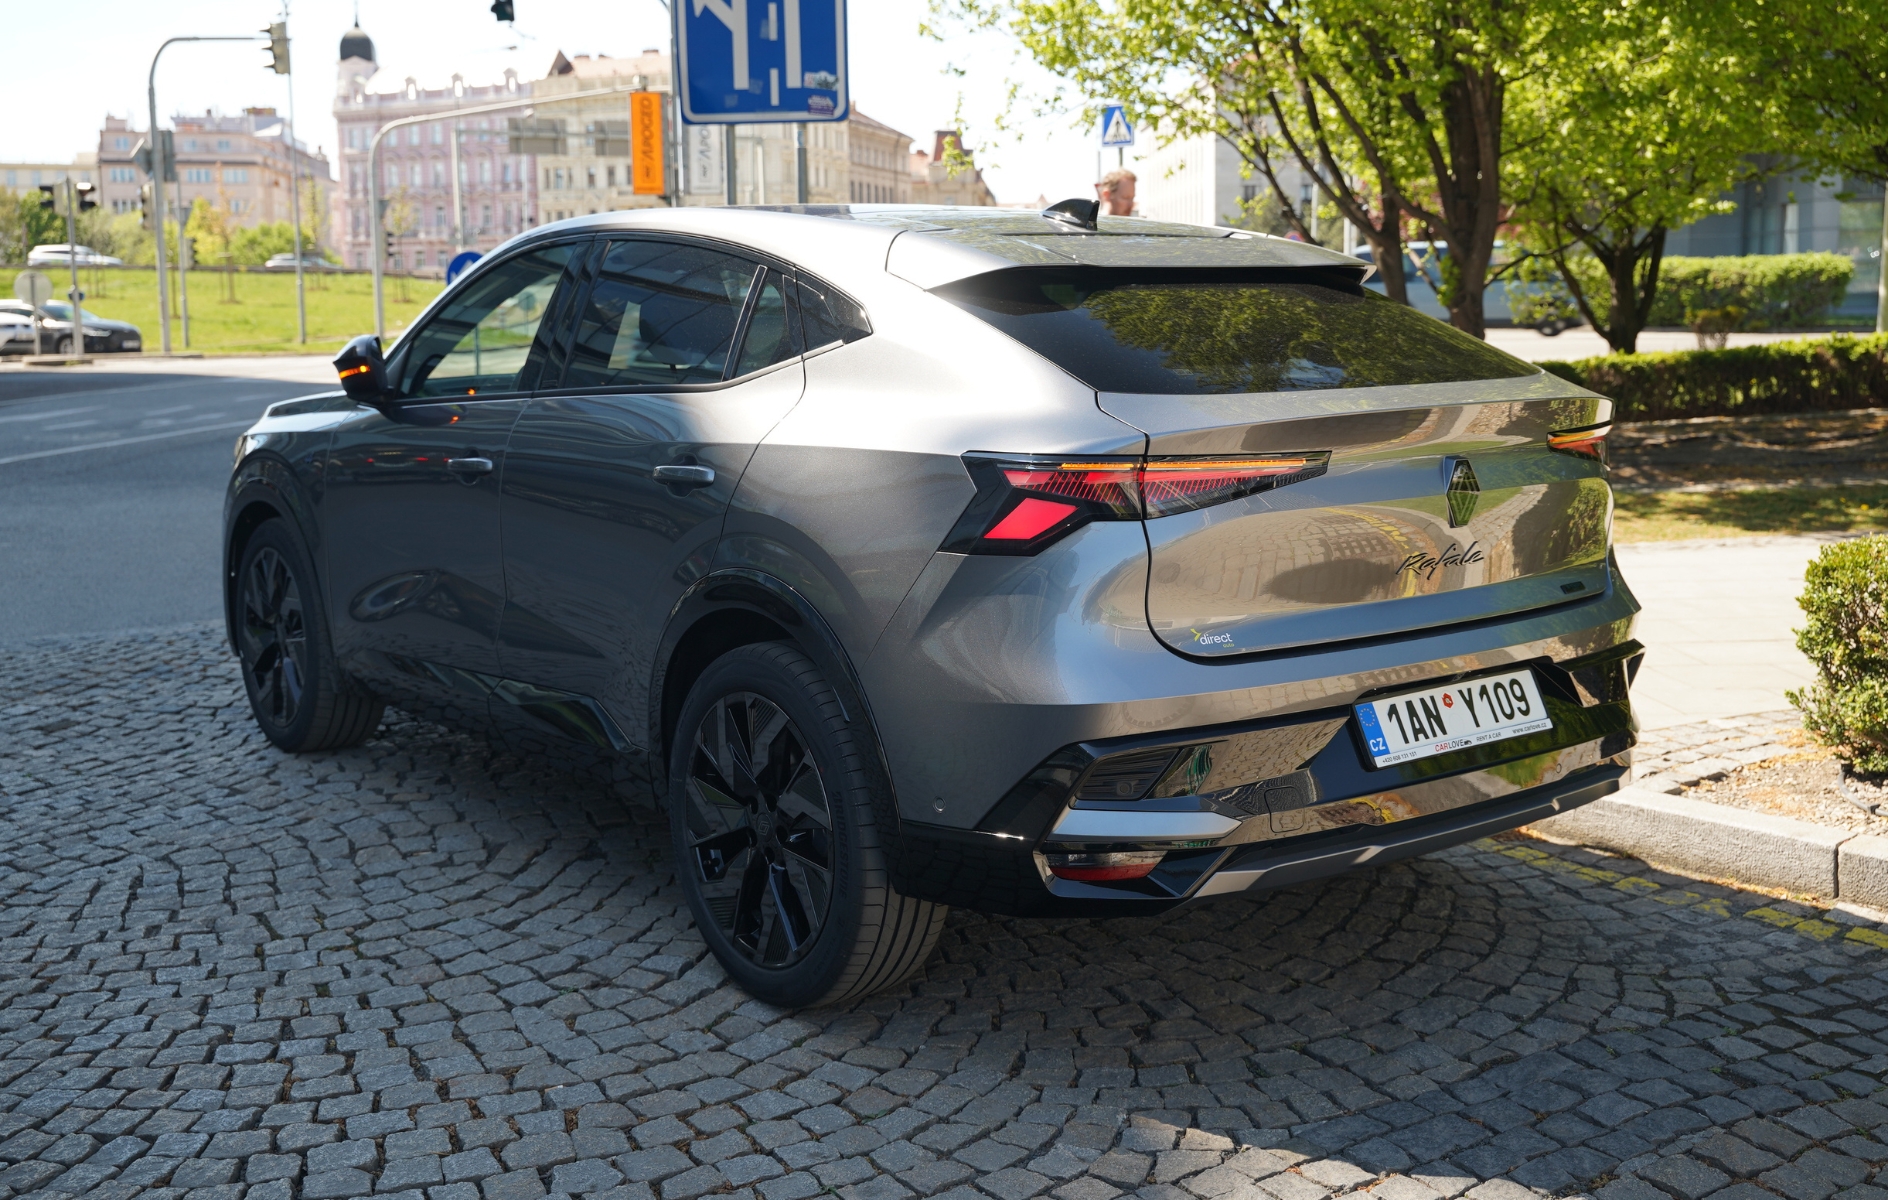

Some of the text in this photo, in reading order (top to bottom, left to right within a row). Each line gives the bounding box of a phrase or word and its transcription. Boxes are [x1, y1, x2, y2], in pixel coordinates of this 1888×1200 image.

[639, 98, 654, 161] APOGEO
[698, 124, 712, 160] APO
[1395, 541, 1484, 580] Rafale
[1200, 633, 1233, 645] direct
[1387, 678, 1531, 744] 1AN Y109
[1476, 734, 1489, 742] RENT
[1492, 731, 1502, 739] CAR
[1512, 722, 1547, 734] www.carlove.cz
[1369, 737, 1386, 753] CZ
[1434, 739, 1465, 752] CARLOVE
[831, 791, 849, 899] BRIDGESTONE
